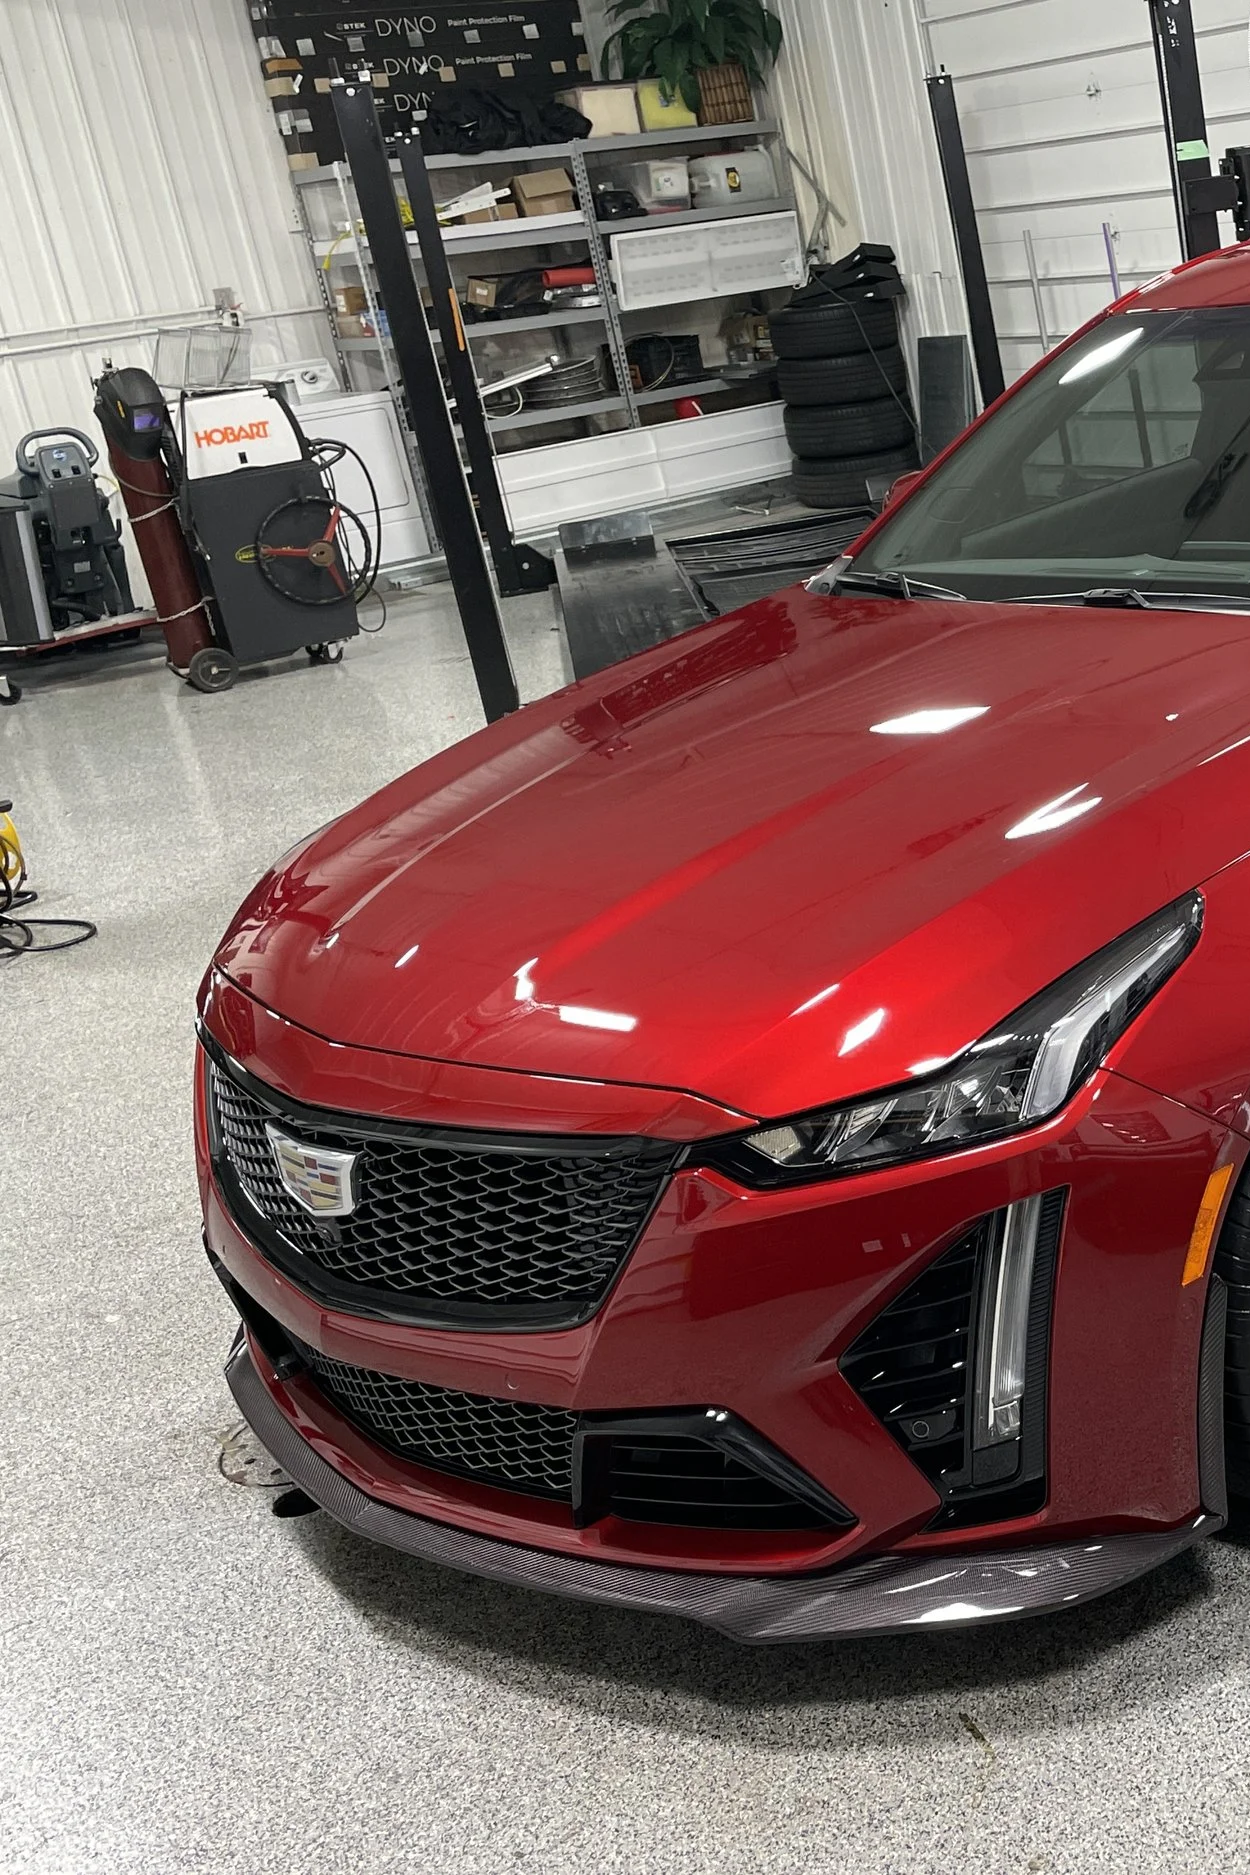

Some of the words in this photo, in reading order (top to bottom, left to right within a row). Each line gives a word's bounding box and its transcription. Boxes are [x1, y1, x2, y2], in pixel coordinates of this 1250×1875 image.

[374, 15, 437, 37] DYNO
[447, 18, 468, 27] Paint
[468, 16, 508, 25] Protection
[508, 14, 526, 22] Film
[383, 54, 444, 76] DYNO
[393, 91, 432, 112] DYN
[194, 421, 269, 449] HOBART
